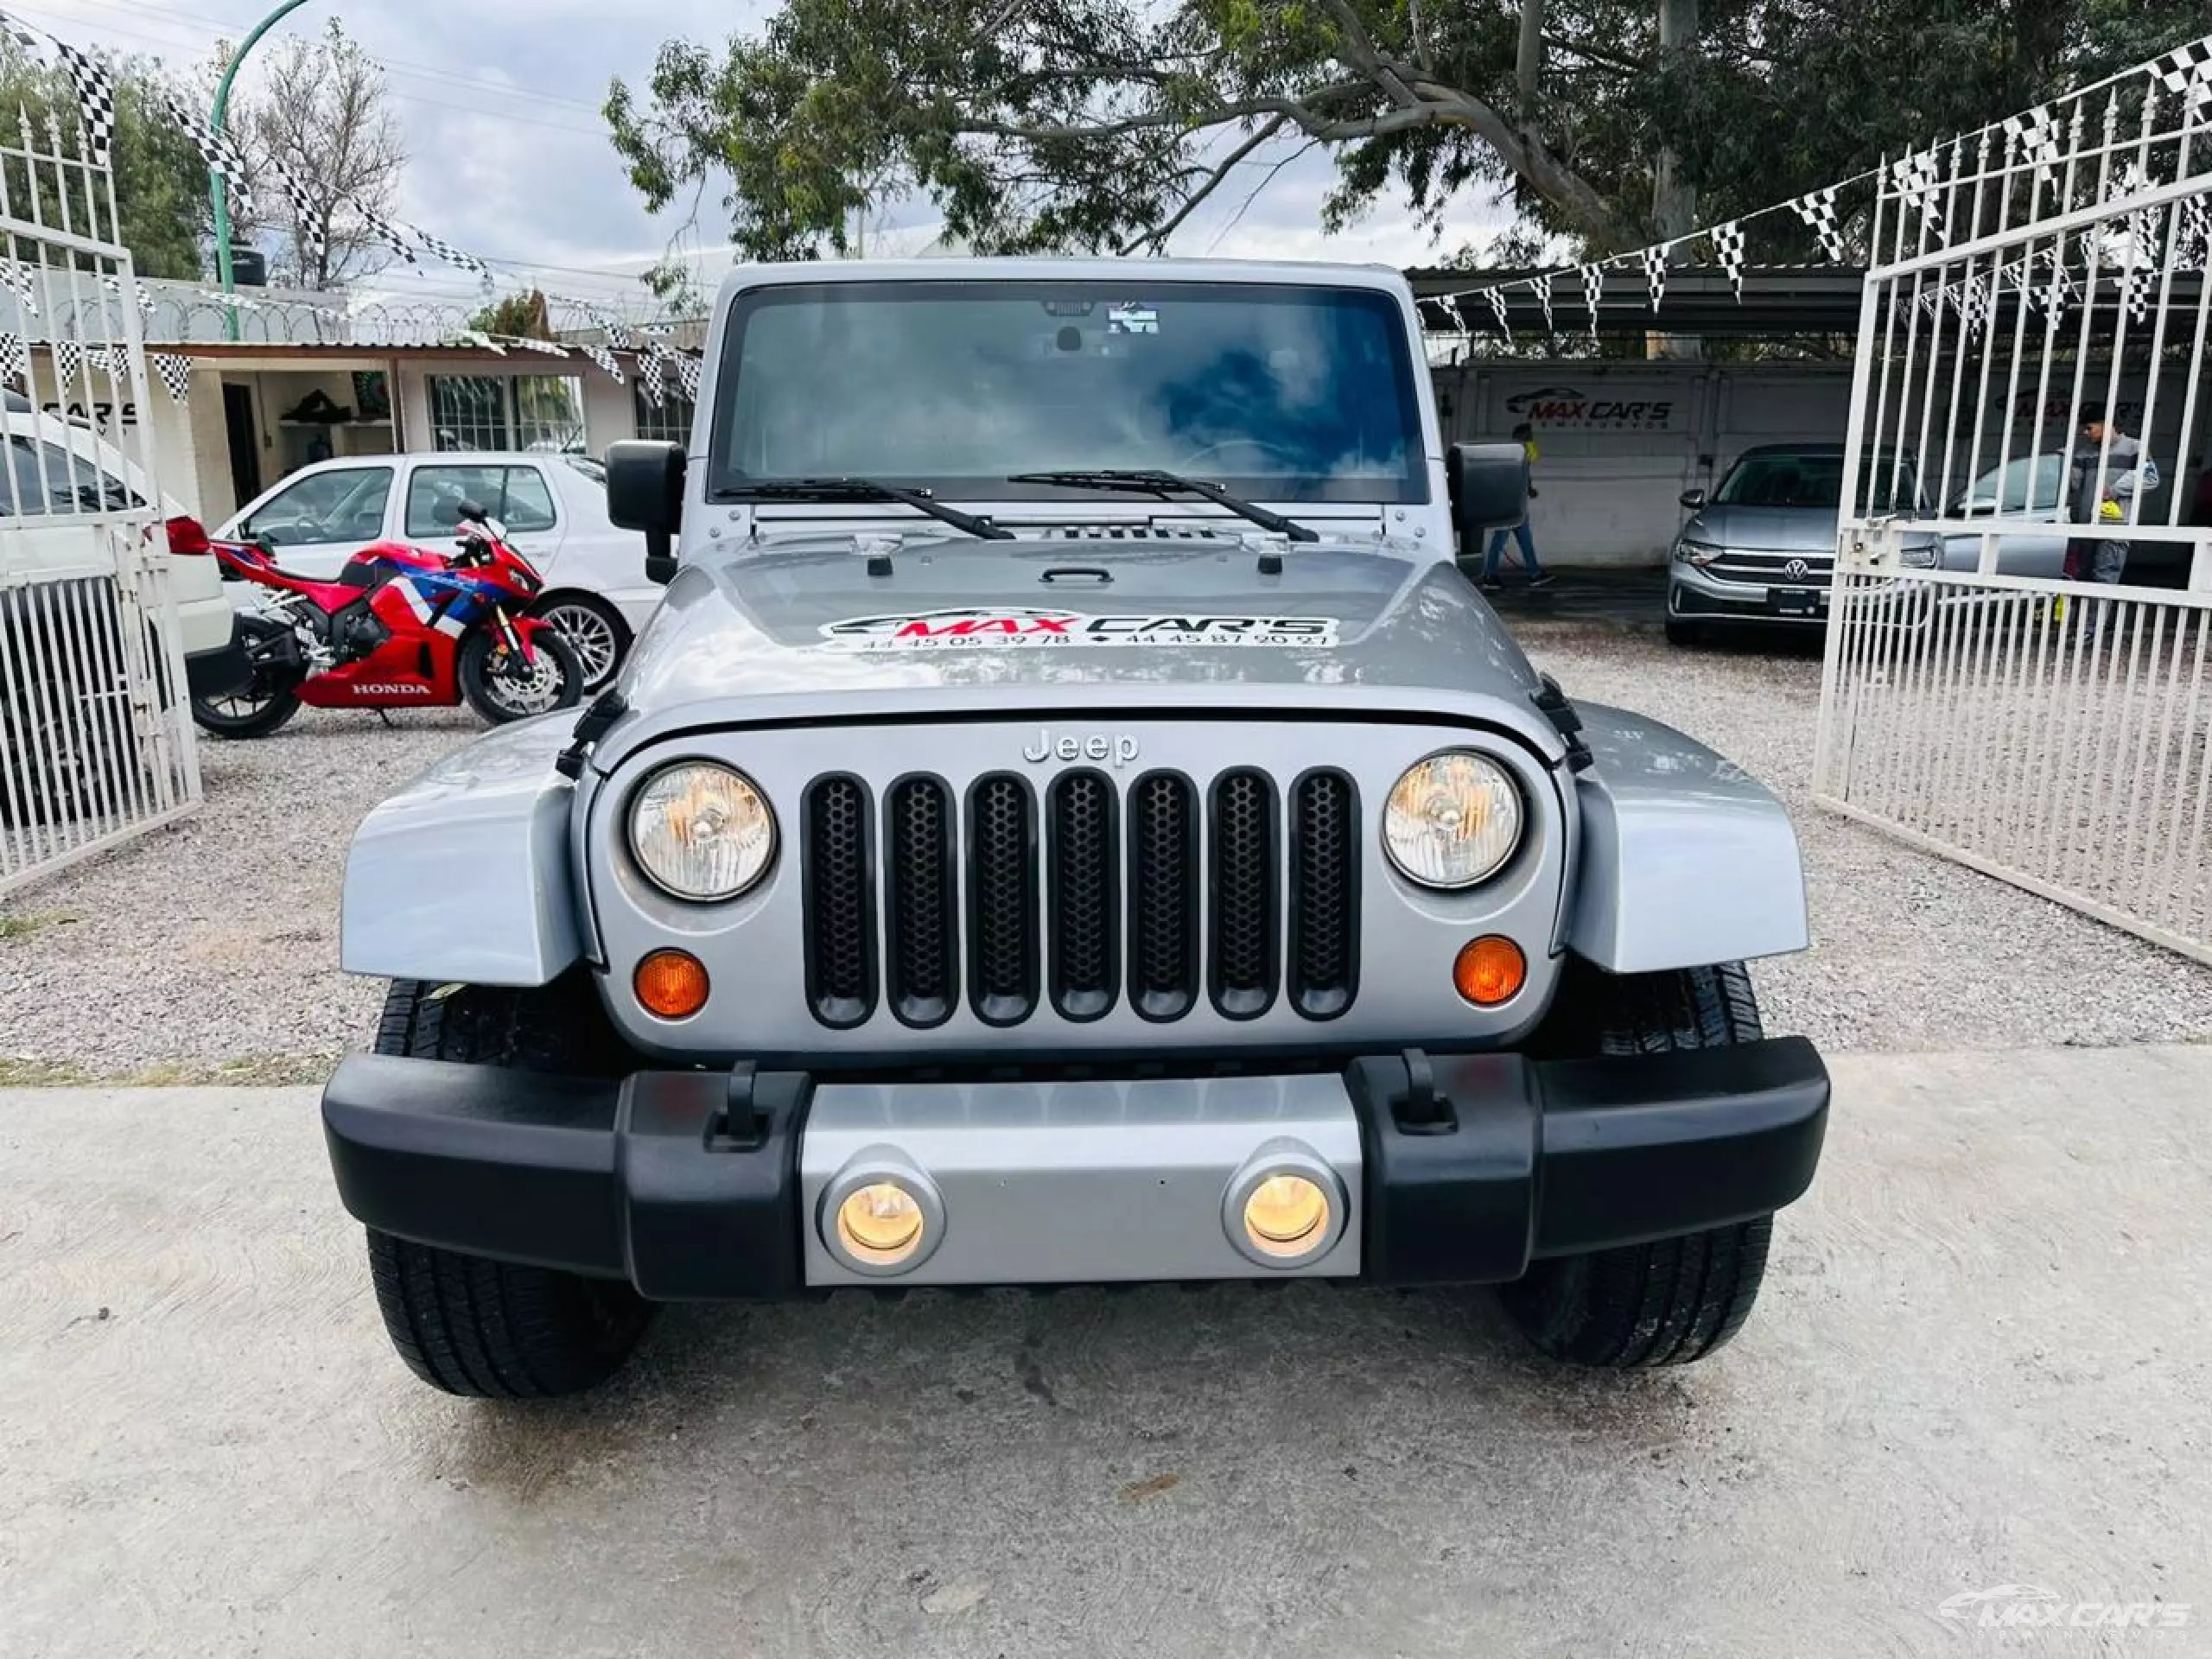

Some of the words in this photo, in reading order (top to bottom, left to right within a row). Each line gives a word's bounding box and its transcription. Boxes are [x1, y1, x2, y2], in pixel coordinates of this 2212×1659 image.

[42, 402, 138, 426] CARS
[1528, 402, 1588, 421] MAX
[1589, 402, 1674, 421] CAR'S
[894, 617, 1079, 637] MAX
[1085, 617, 1328, 636] CAR'S
[949, 636, 982, 646] 05
[1126, 633, 1156, 644] 44
[1169, 633, 1201, 644] 45
[352, 683, 432, 696] HONDA
[1022, 728, 1140, 770] Jeep
